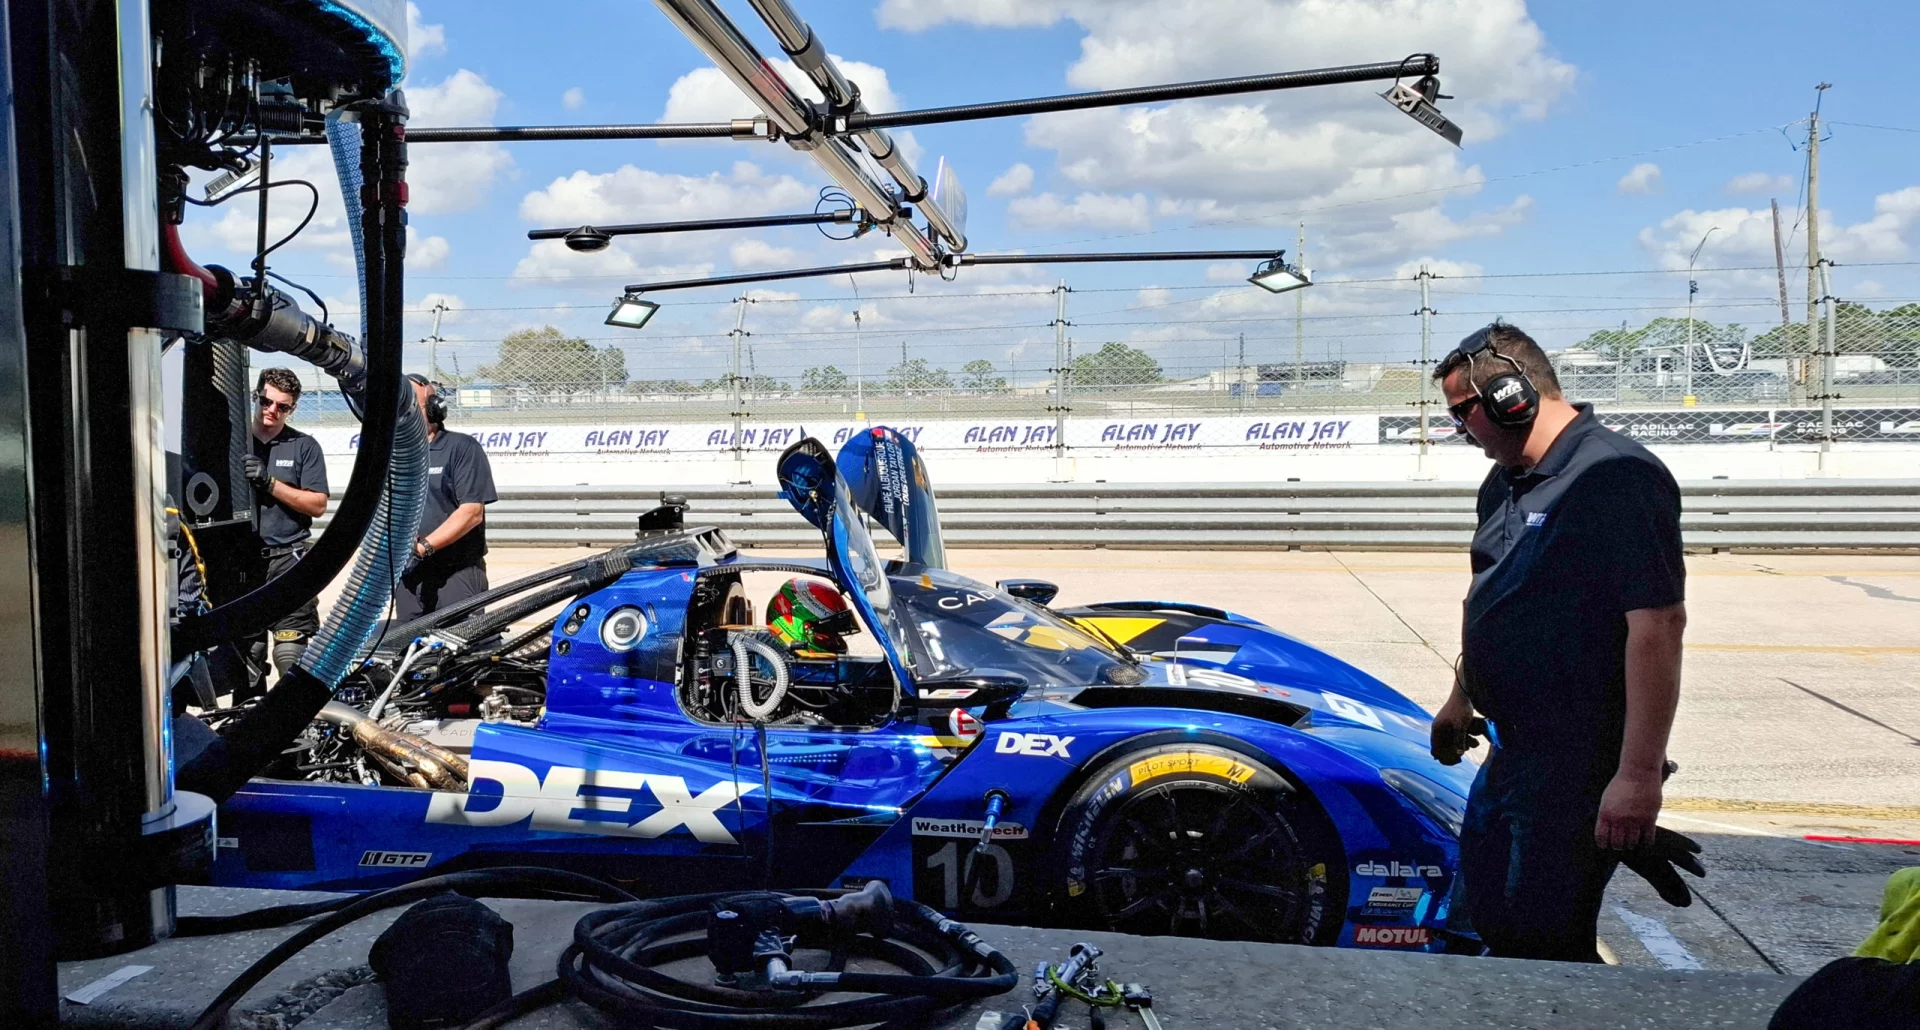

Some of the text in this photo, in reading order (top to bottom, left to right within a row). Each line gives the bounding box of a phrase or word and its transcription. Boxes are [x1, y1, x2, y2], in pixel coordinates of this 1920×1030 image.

[585, 429, 669, 448] ALAN JAY
[759, 428, 794, 447] JAY
[964, 425, 1057, 445] ALAN JAY
[1102, 423, 1201, 443] ALAN JAY
[1246, 420, 1351, 442] ALAN JAY
[515, 431, 548, 450] JAY
[977, 445, 1023, 453] Automotive
[1114, 442, 1202, 451] Automotive Network
[1260, 440, 1352, 450] Automotive Network
[519, 449, 550, 457] Network
[995, 731, 1076, 758] DEX
[1138, 759, 1200, 775] PILOT SPORT
[1226, 763, 1247, 778] M
[425, 759, 763, 845] DEX
[381, 854, 427, 864] GTP
[926, 841, 1015, 908] 10
[1356, 860, 1443, 877] dallara
[1357, 928, 1429, 943] MOTUL
